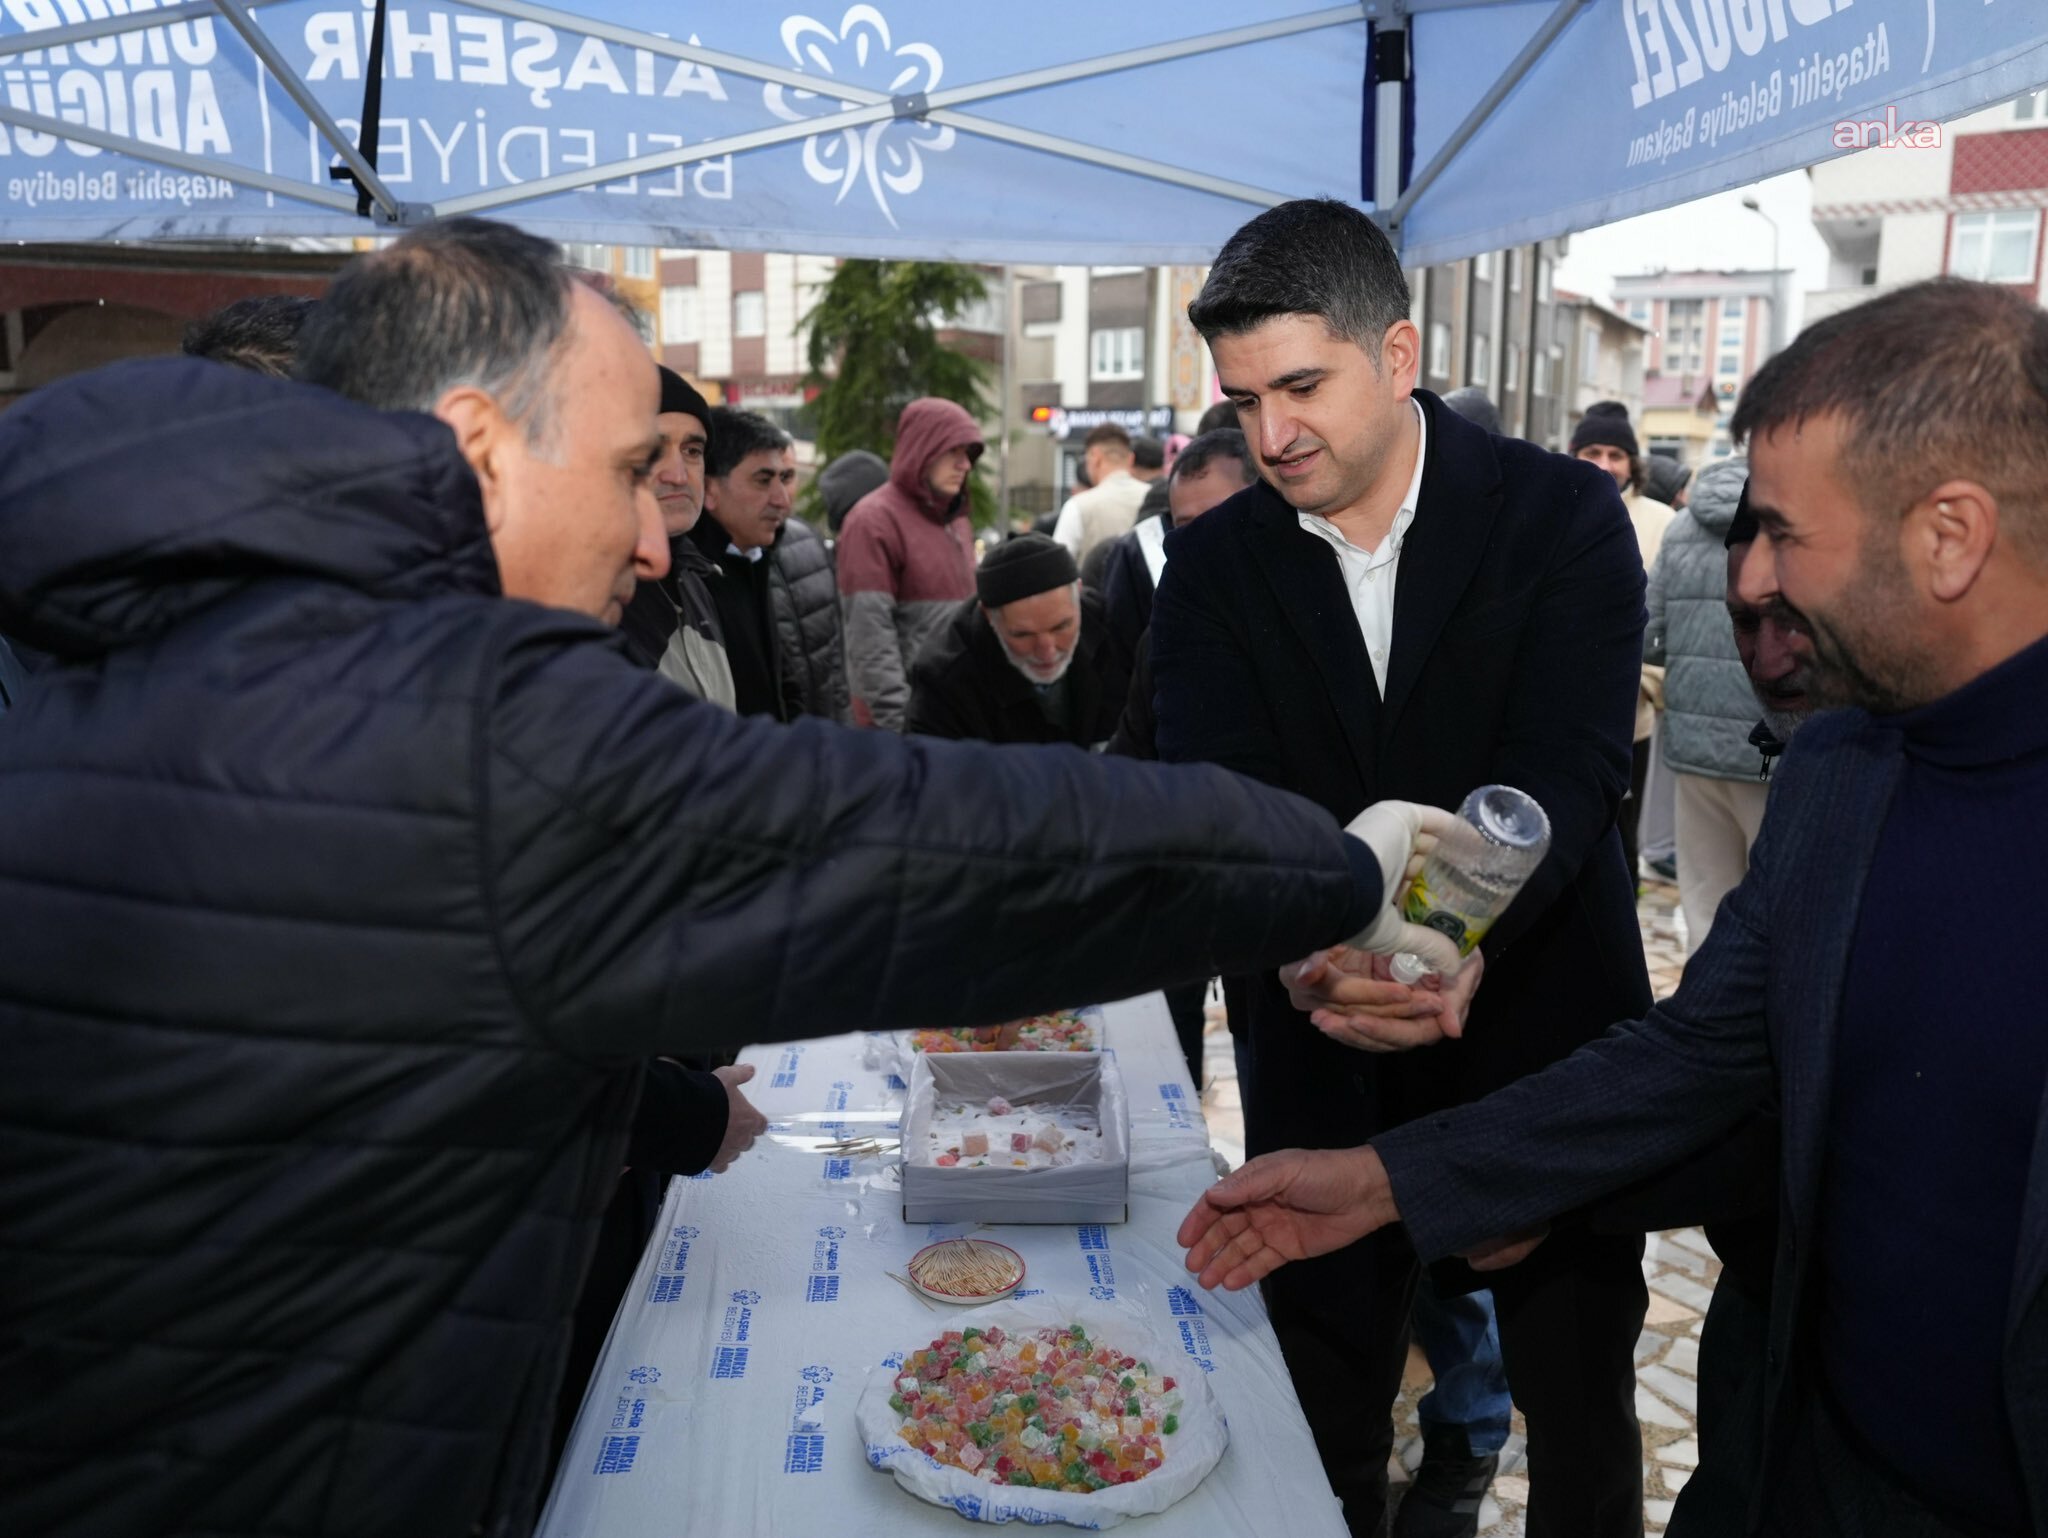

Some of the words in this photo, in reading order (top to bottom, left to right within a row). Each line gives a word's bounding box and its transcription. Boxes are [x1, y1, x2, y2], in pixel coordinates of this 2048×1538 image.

[736, 1307, 752, 1342] ATAŞEHİR
[730, 1347, 749, 1379] ONURSAL
[616, 1435, 640, 1474] ONURSAL
[807, 1435, 825, 1474] ONURSAL
